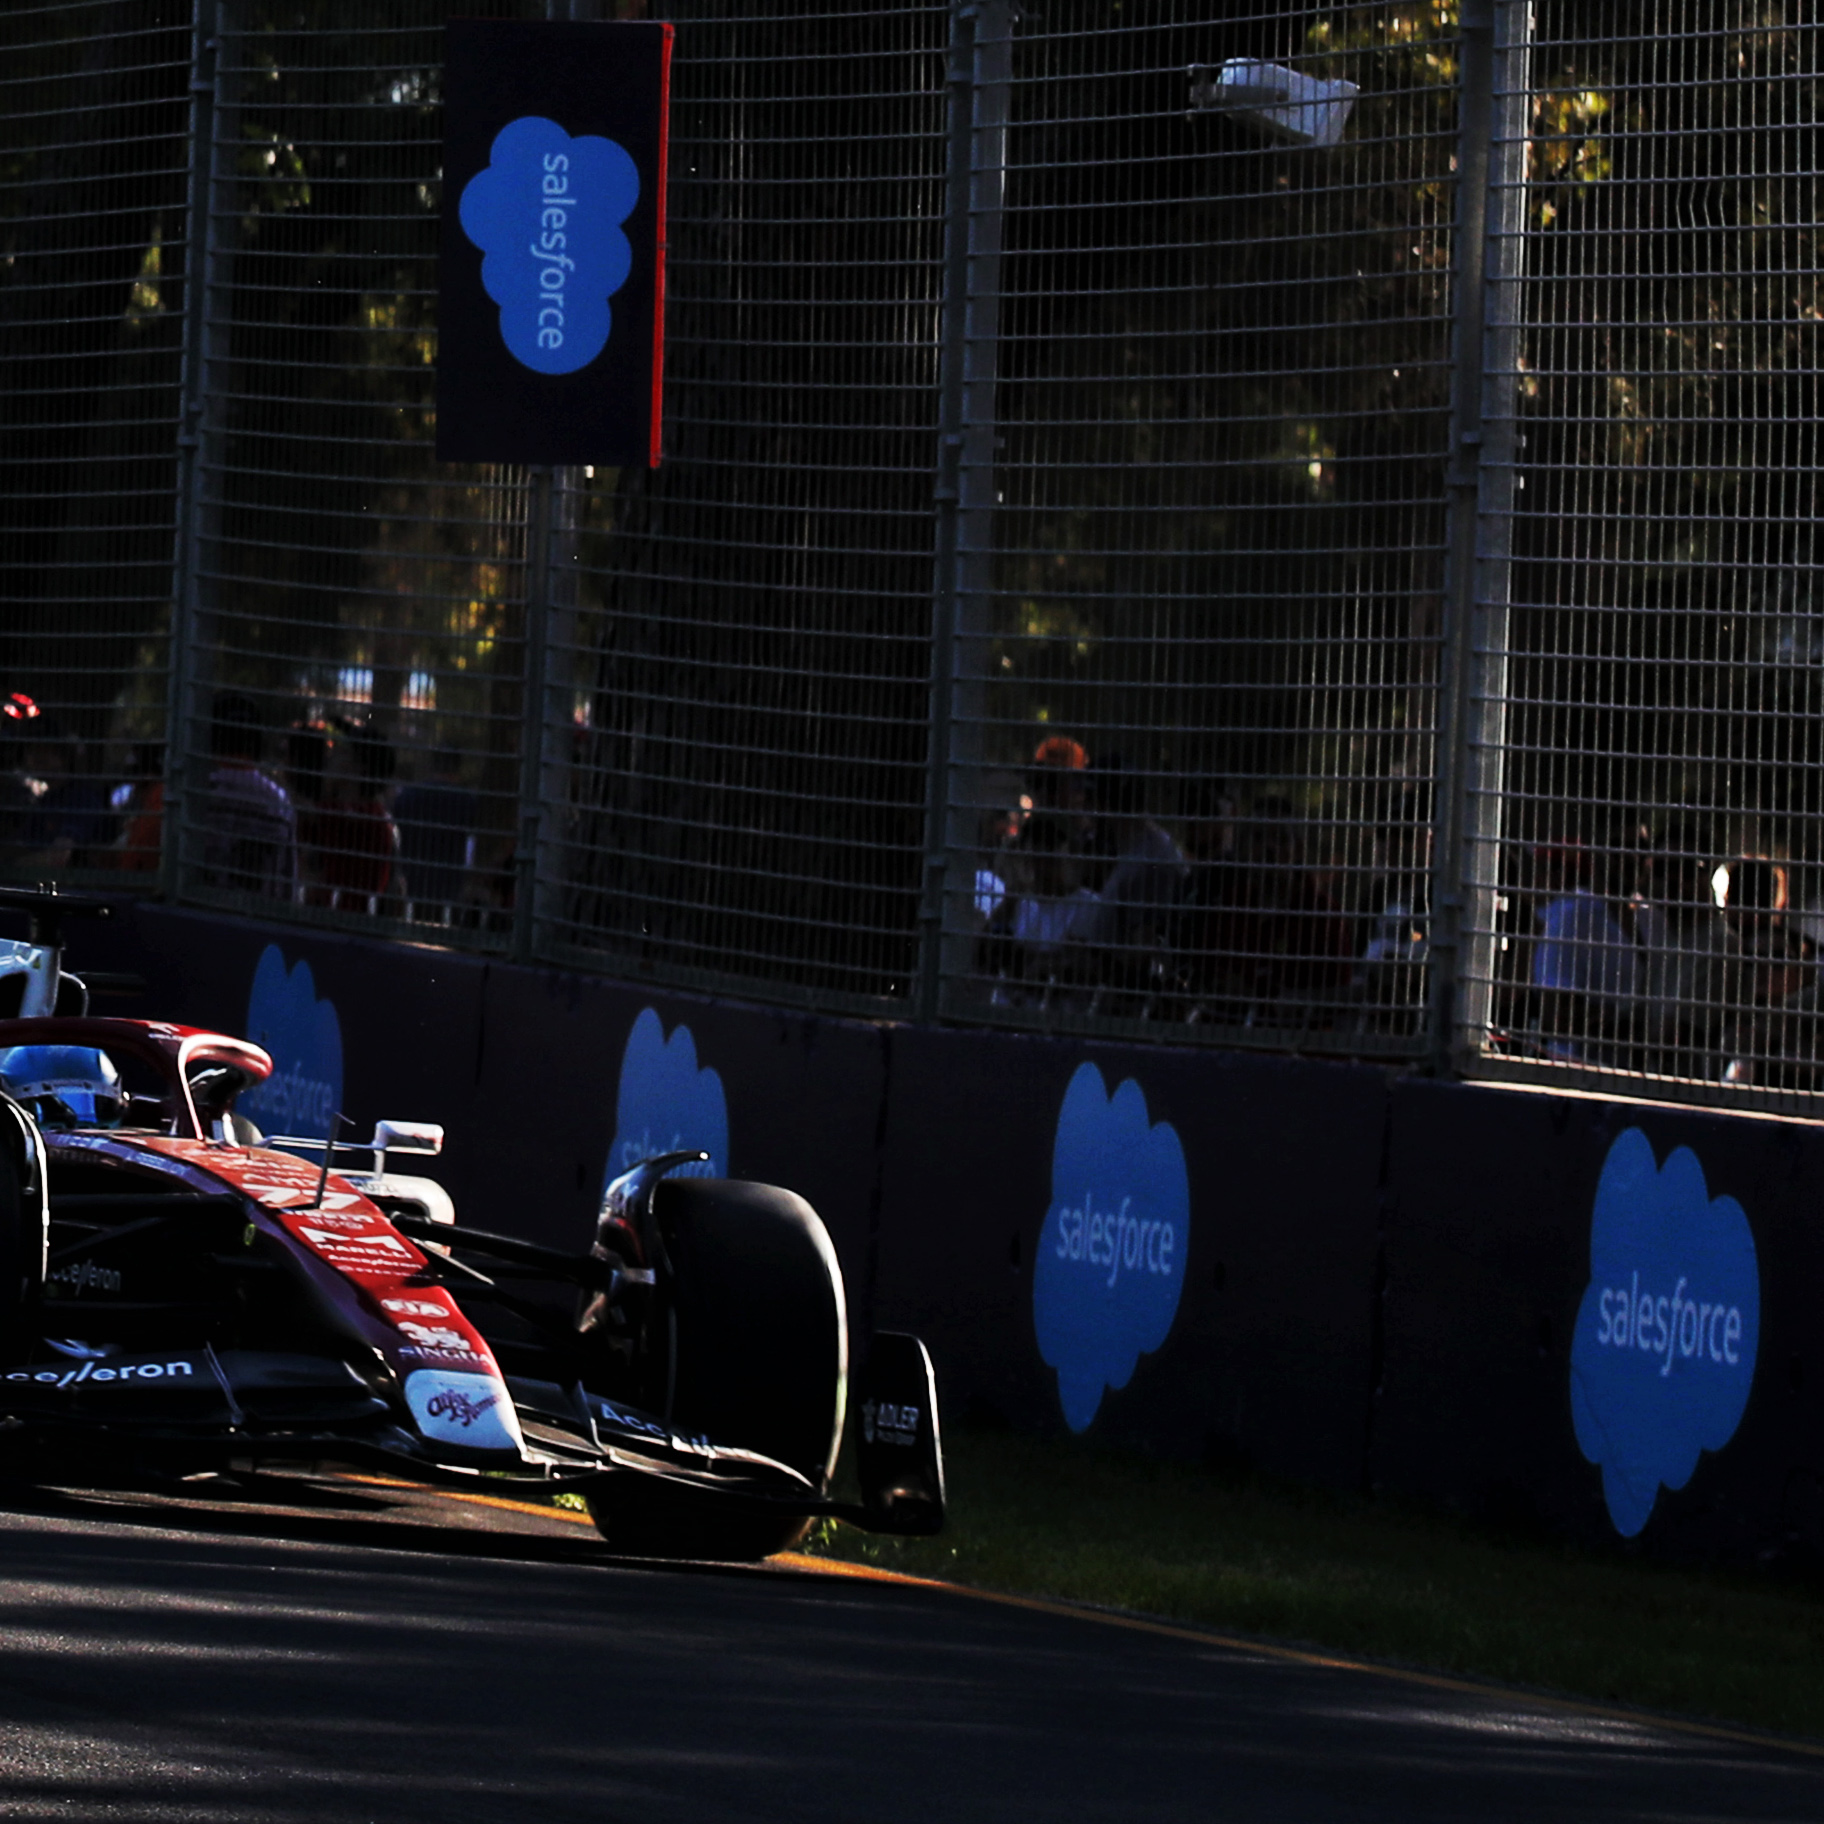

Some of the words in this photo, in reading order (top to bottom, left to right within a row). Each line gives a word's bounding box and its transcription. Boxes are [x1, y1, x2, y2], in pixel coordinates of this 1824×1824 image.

[529, 152, 578, 350] salesforce
[1056, 1193, 1175, 1288] salesforce
[1597, 1270, 1743, 1376] salesforce
